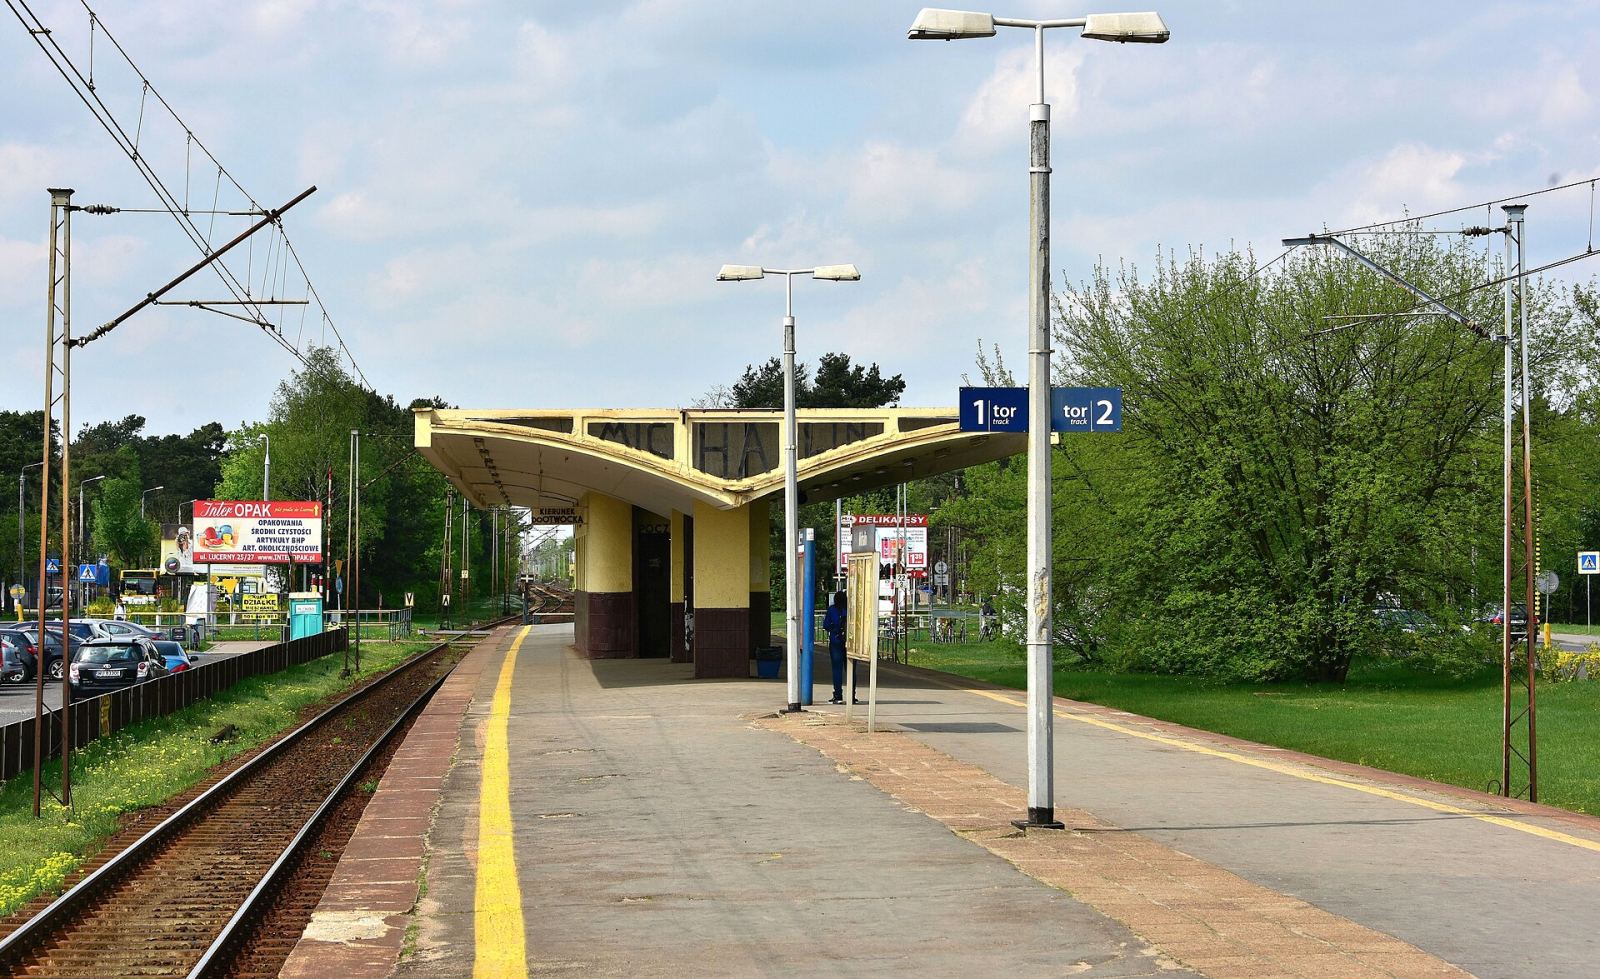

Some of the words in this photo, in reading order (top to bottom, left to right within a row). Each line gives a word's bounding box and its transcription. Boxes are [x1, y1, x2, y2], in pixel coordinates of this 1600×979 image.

[973, 399, 985, 425] 1
[992, 405, 1017, 418] tor
[1063, 404, 1088, 418] tor
[1096, 400, 1114, 425] 2
[200, 500, 233, 516] Inter
[234, 503, 272, 517] OPAK
[858, 516, 924, 524] DELIKATESY
[251, 527, 276, 535] ŚRODKI
[277, 526, 312, 535] CZYSTOŚCI
[237, 553, 255, 561] 25/27
